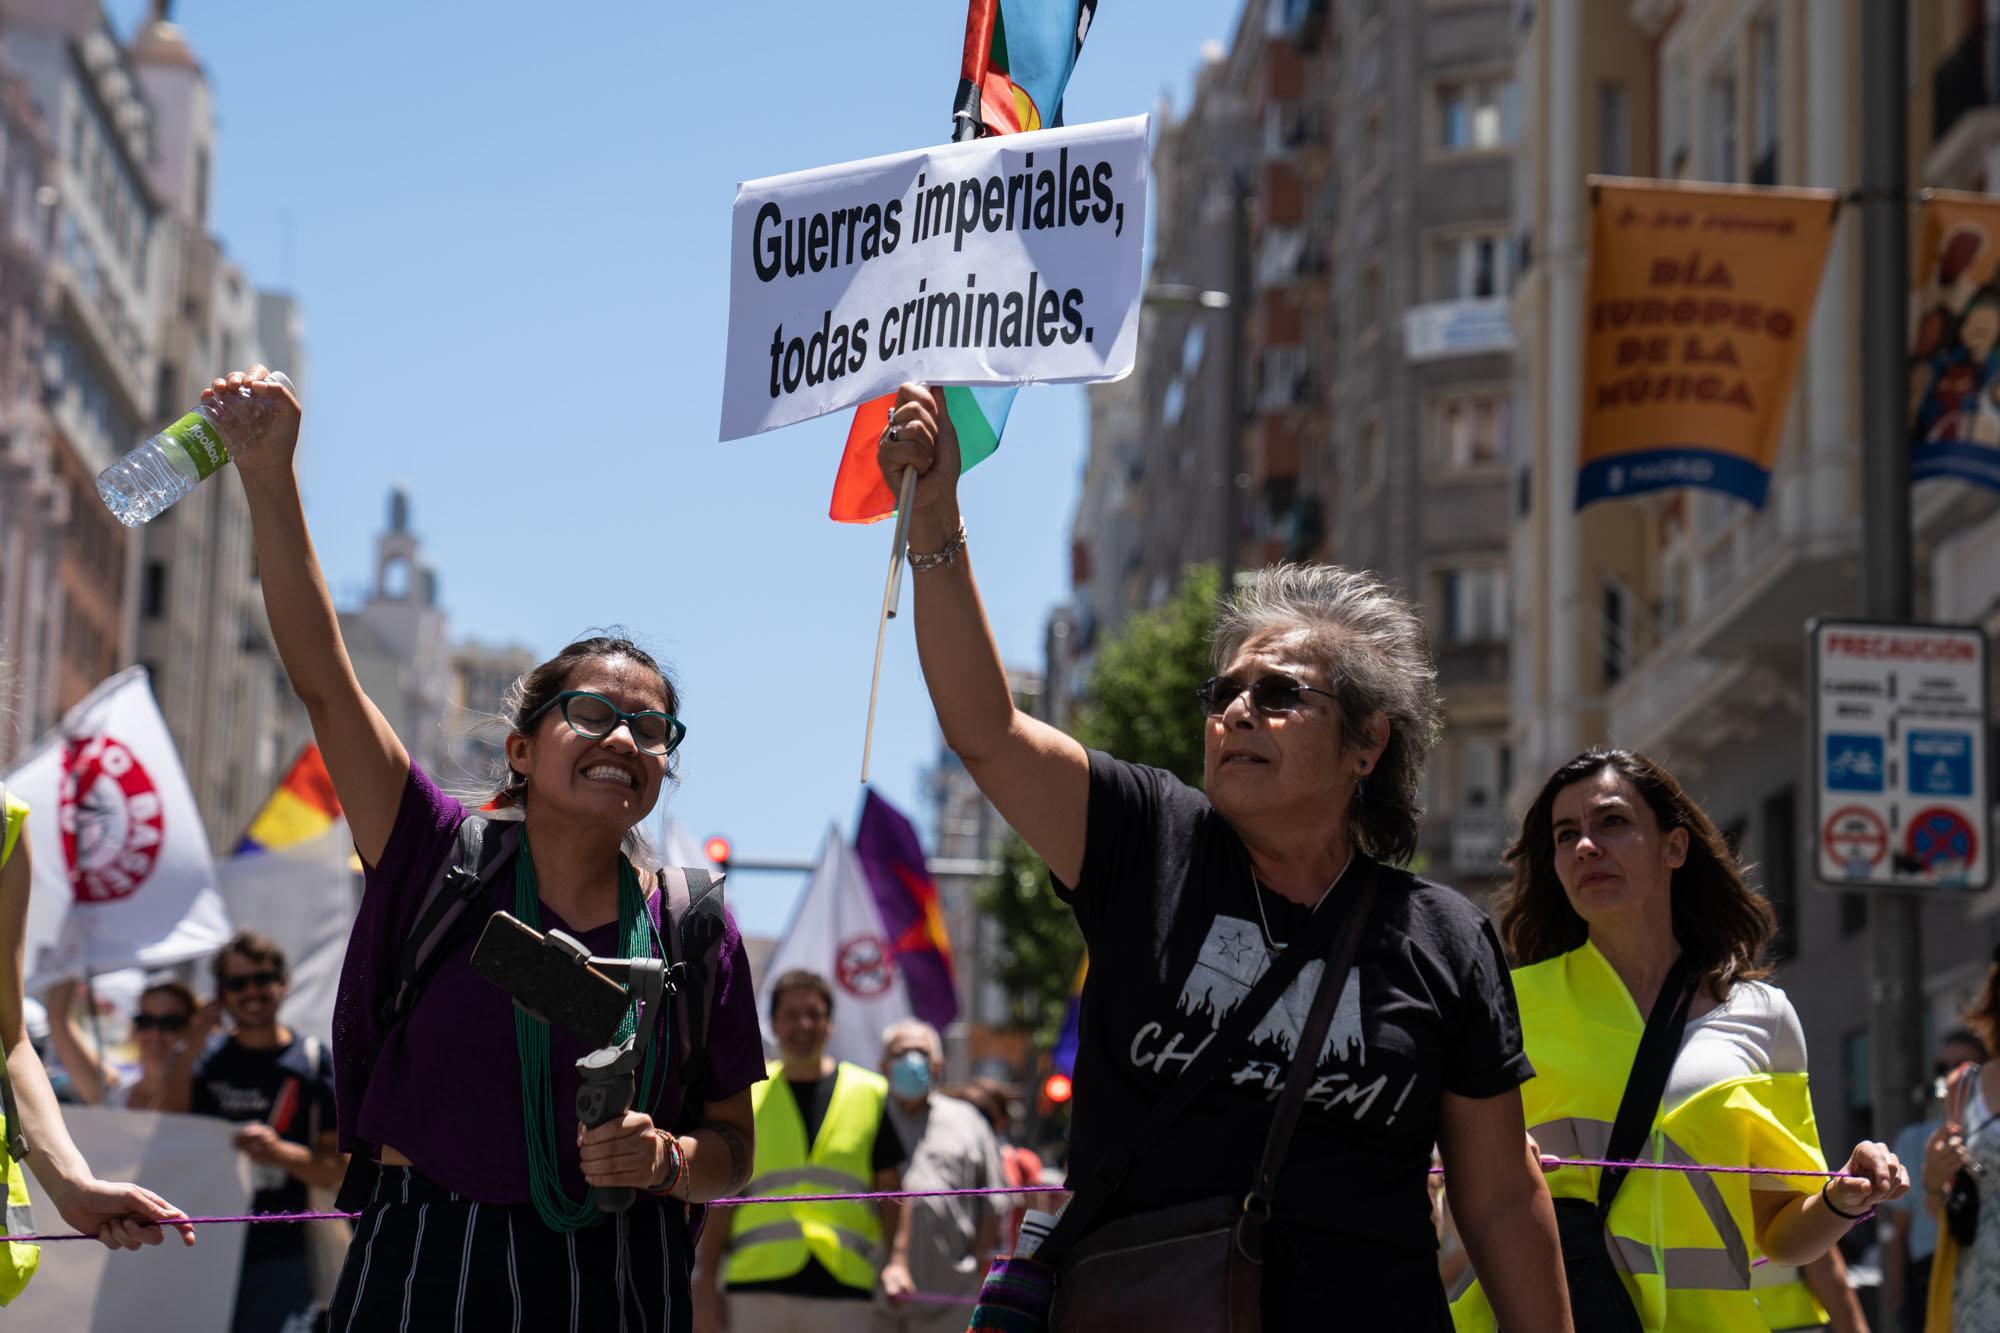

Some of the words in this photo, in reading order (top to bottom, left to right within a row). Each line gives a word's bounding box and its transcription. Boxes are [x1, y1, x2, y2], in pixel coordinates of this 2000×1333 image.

[752, 199, 902, 283] Guerras
[911, 147, 1124, 252] imperiales,
[1649, 250, 1733, 288] DÍA
[769, 310, 869, 399] todas
[878, 271, 1094, 361] criminales.
[1617, 335, 1670, 365] DE
[1683, 334, 1741, 366] LA
